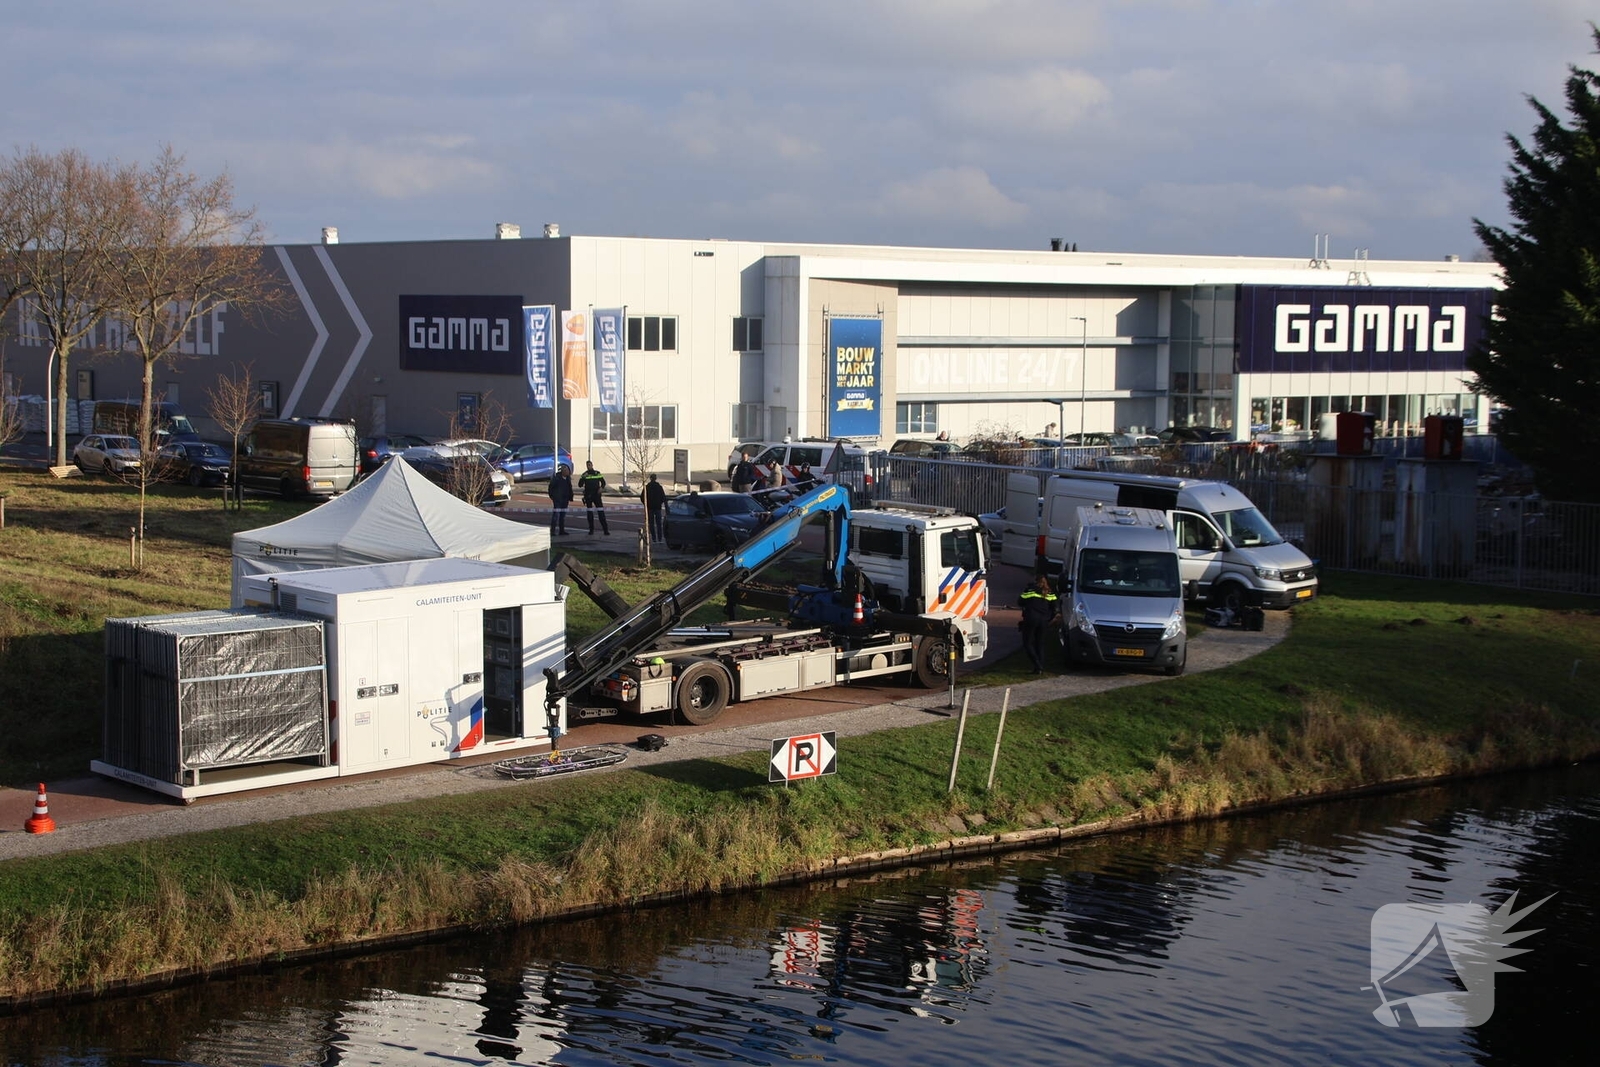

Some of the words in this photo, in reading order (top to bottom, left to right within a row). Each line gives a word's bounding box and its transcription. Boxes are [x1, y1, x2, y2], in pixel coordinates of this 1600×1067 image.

[408, 317, 510, 352] GAMMA
[1274, 304, 1467, 353] GAMMA
[836, 346, 875, 362] BOUW
[836, 361, 875, 375] MARKT
[913, 352, 1009, 385] ONLINE
[1017, 350, 1080, 387] 24/7
[846, 375, 874, 388] JAAR
[259, 544, 299, 557] POLITIE
[415, 592, 483, 607] CALAMITEITEN-UNIT
[416, 705, 453, 720] POLITIE
[795, 741, 814, 772] P
